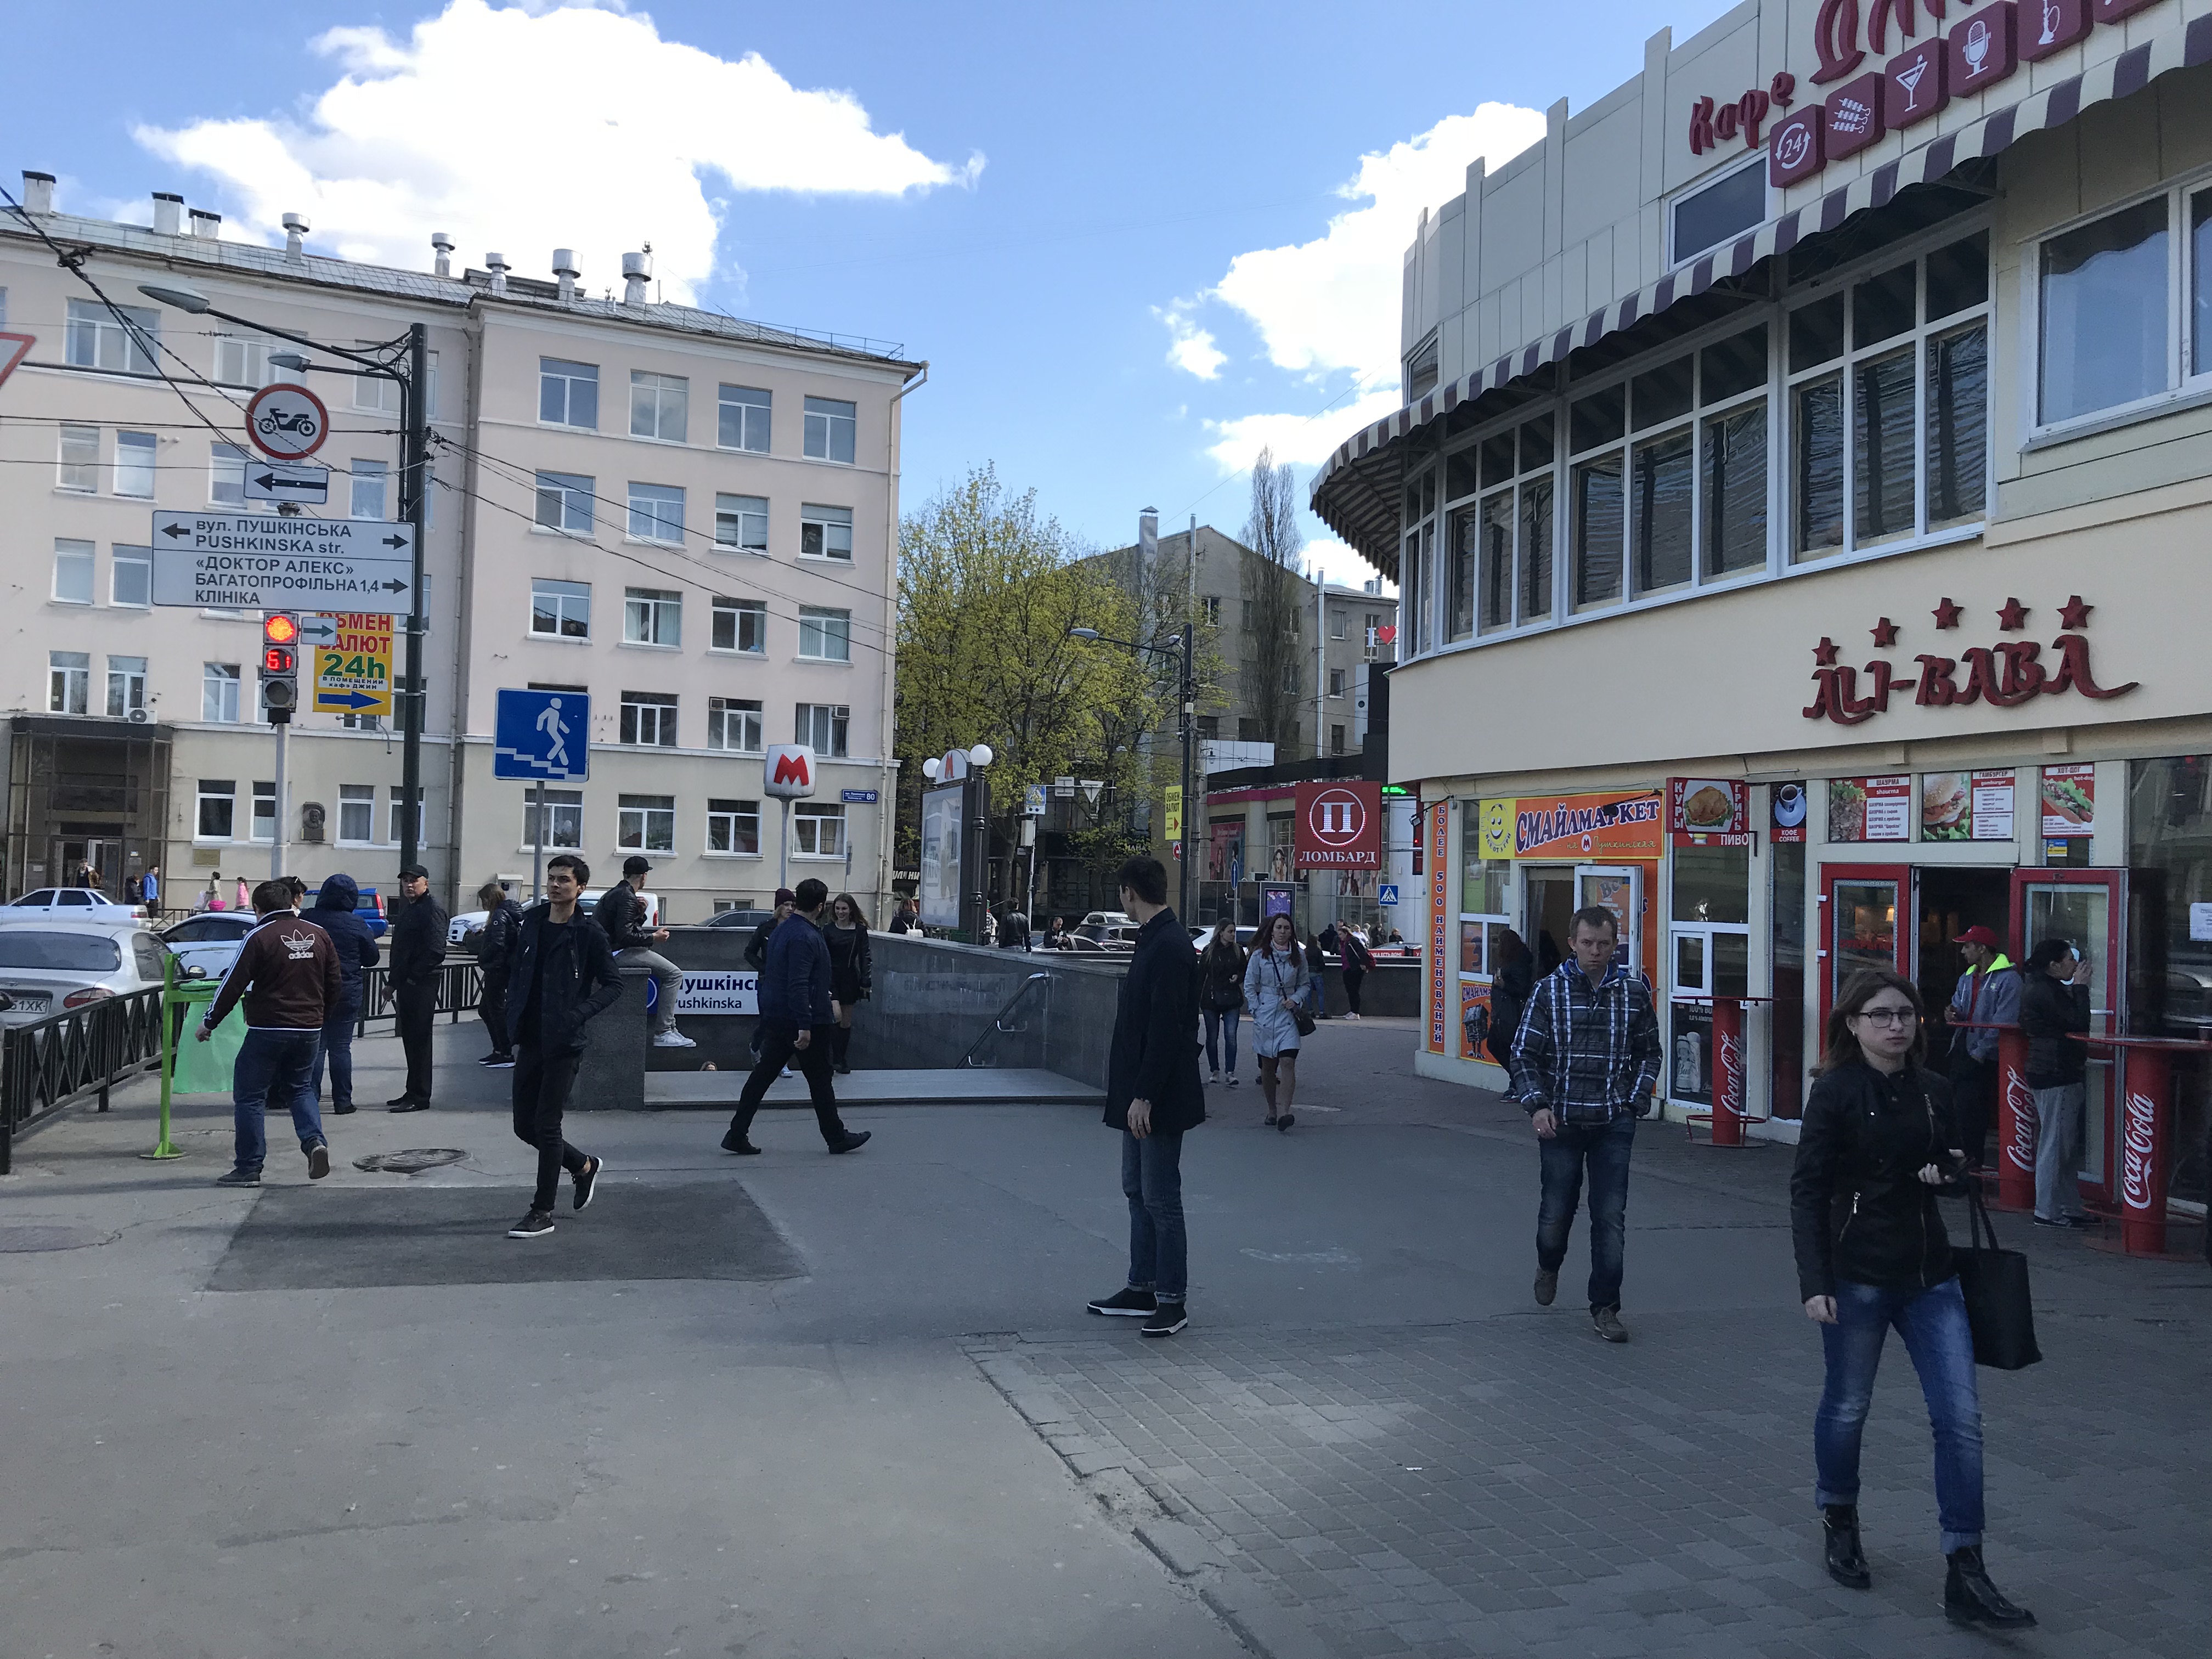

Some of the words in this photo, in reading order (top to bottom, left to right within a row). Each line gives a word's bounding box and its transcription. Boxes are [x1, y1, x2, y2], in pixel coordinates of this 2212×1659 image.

[1784, 133, 1802, 159] 24
[196, 520, 231, 533] вул.
[236, 519, 352, 538] ПУШКІНСЬКА
[195, 535, 314, 553] PUSHKINSKA
[318, 541, 345, 554] str.
[196, 556, 280, 572] «ДОКТОР
[284, 559, 354, 575] АЛЕКС»
[195, 573, 358, 592] БАГАТОПРОФІЛЬНА
[360, 579, 380, 594] 1,4
[195, 590, 261, 605] КЛІНІКА
[319, 634, 391, 654] АЛЮТ
[323, 653, 386, 679] 24h
[1674, 782, 1684, 828] КУРЫ
[1734, 784, 1742, 831] ГРИЛЬ
[1437, 806, 1445, 857] БОЛЕЕ
[1720, 833, 1749, 845] ПИВО
[1299, 851, 1376, 864] ЛОМБАРД
[1436, 871, 1444, 906] 500
[289, 951, 314, 960] adidas
[1434, 915, 1445, 1043] НАИМЕНОВАНИЙ
[675, 997, 742, 1009] ushkinska
[2007, 1064, 2036, 1172] Coca-Col
